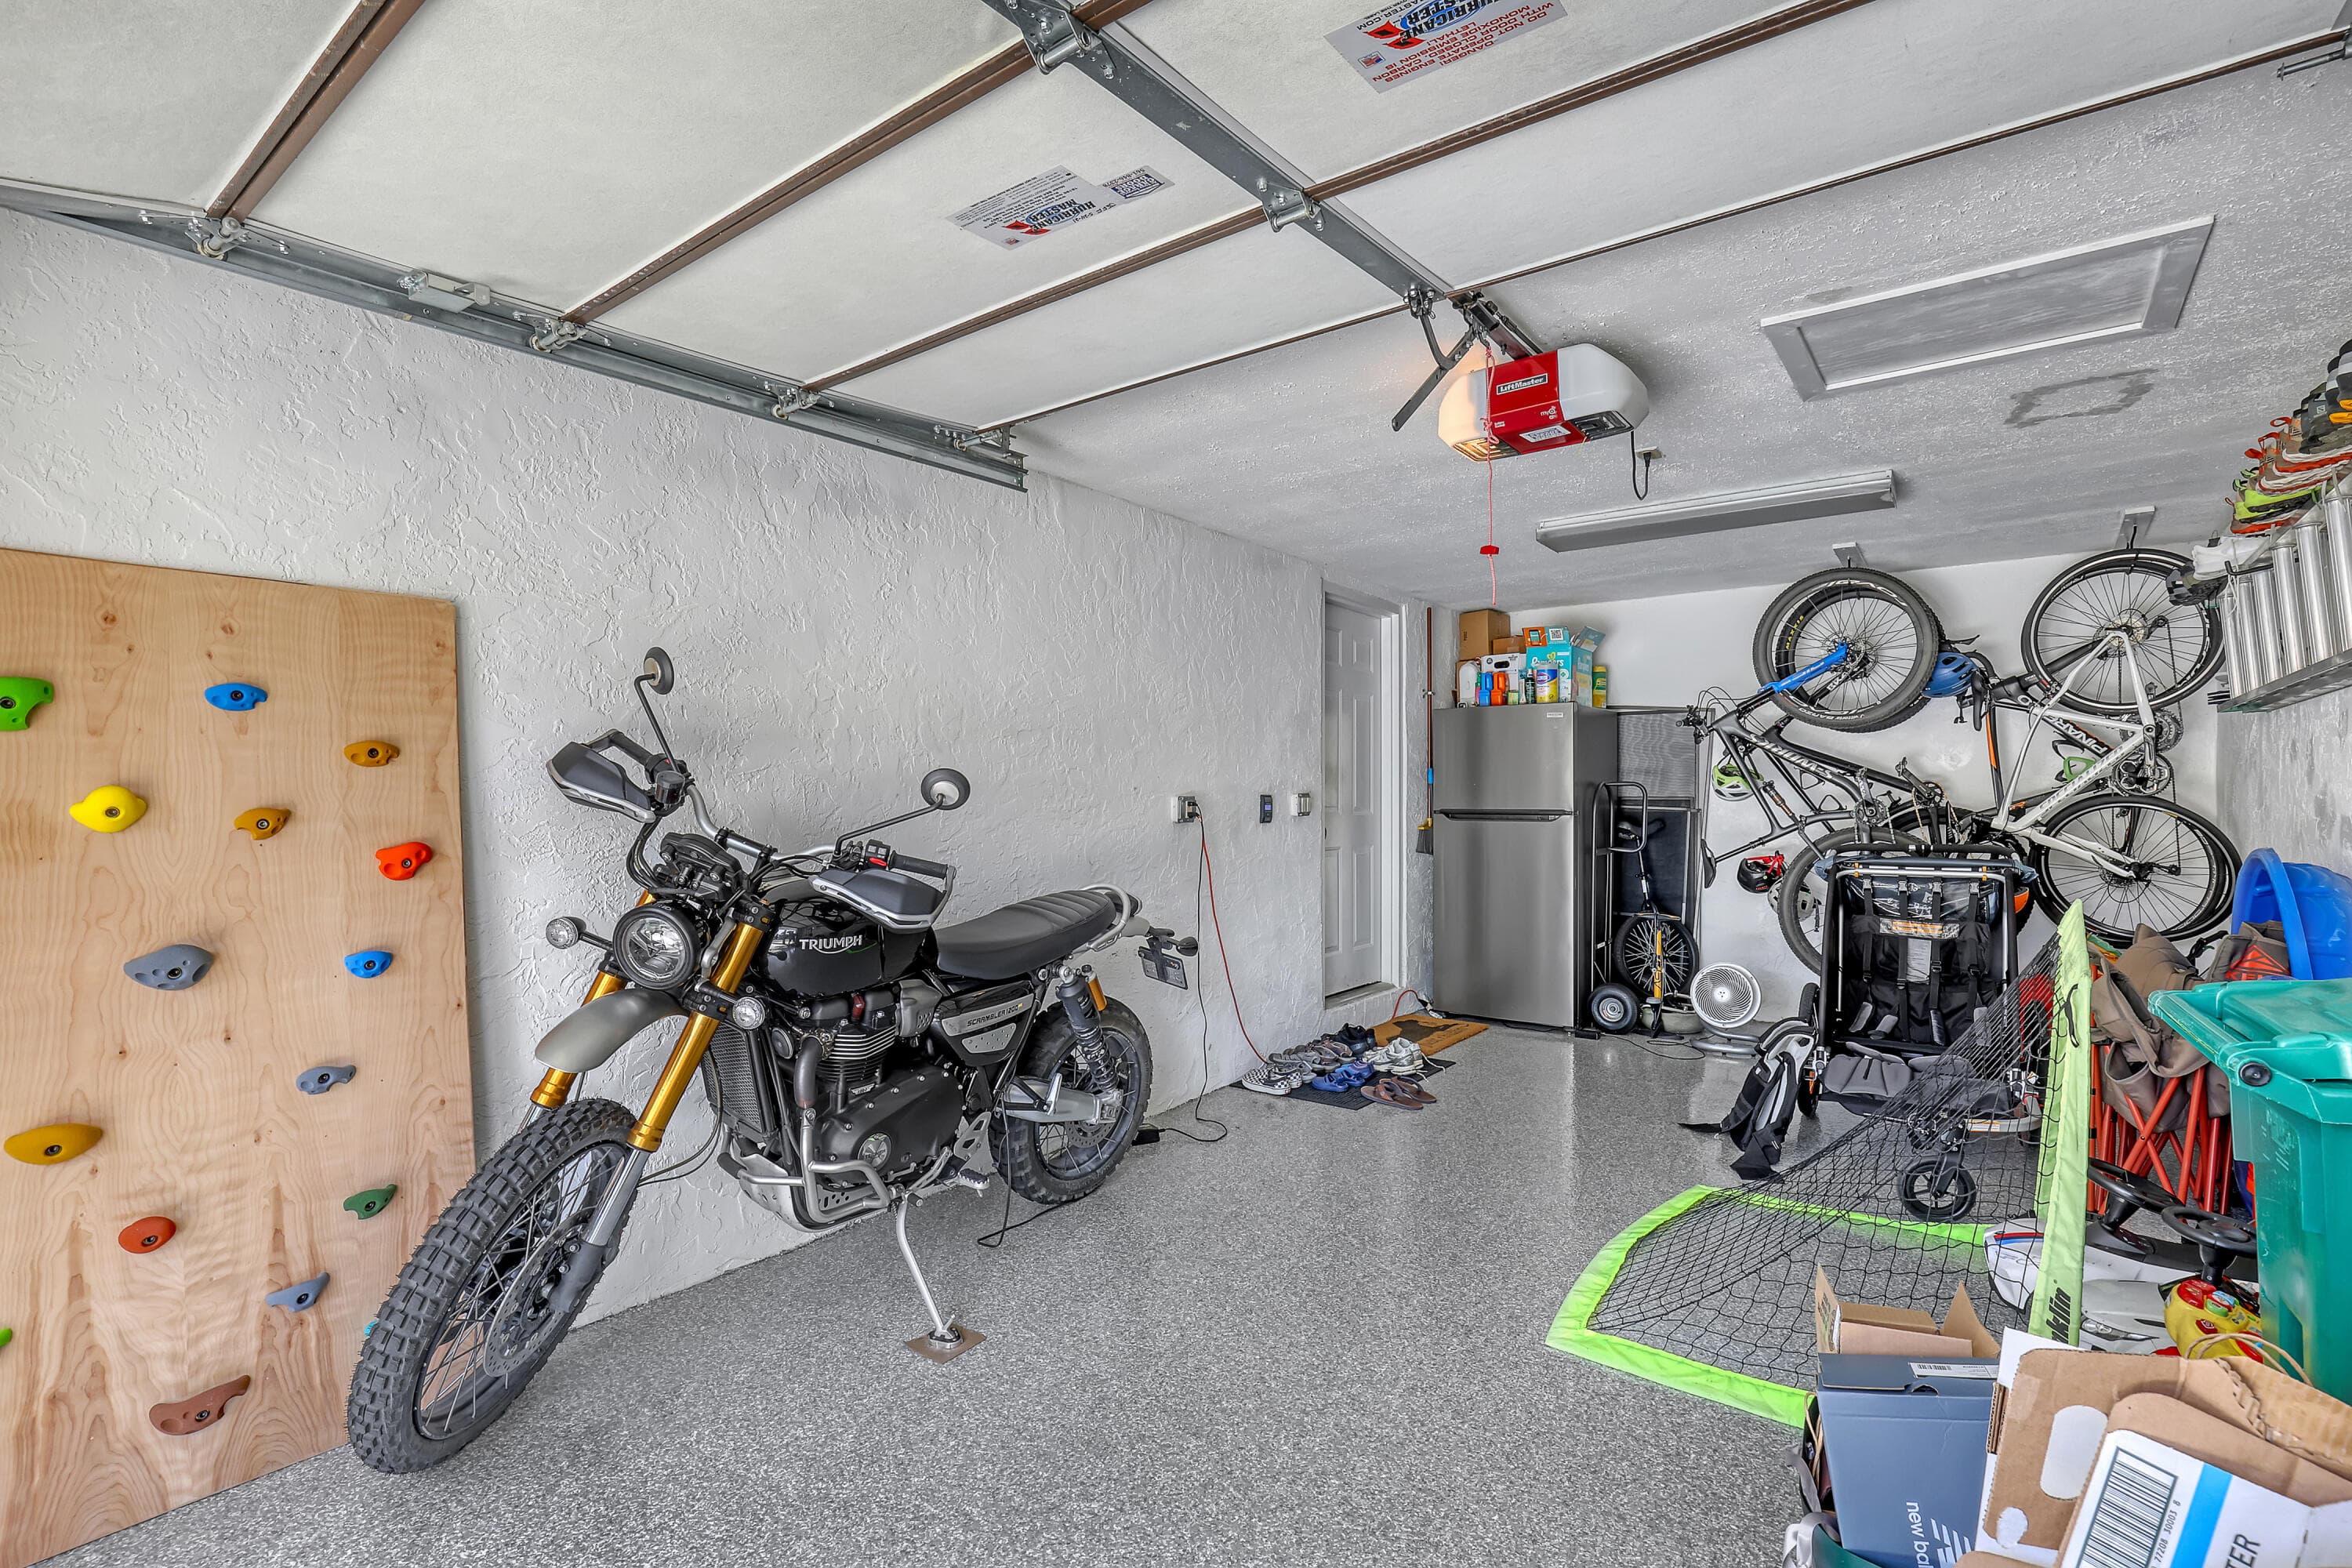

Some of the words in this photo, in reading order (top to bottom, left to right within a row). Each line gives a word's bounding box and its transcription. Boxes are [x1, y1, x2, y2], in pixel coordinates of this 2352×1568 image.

[1459, 5, 1531, 38] MONOXIDE
[1519, 2, 1554, 18] WITH
[1526, 11, 1548, 22] DO
[1425, 21, 1477, 45] LETHAL!
[1479, 17, 1518, 36] DOOR
[1495, 20, 1524, 35] NOT
[1398, 36, 1458, 64] EMISSION
[1424, 34, 1478, 59] CLOSED.
[1436, 34, 1494, 60] OPERATE
[1438, 39, 1495, 65] DANGER!
[1371, 58, 1422, 82] CARBON
[1384, 59, 1436, 82] ENGINES
[1027, 198, 1080, 222] MASTER
[1029, 201, 1097, 231] HURRICANE
[1500, 378, 1544, 392] LiftMaster
[1785, 615, 1805, 650] MAXXIS
[799, 935, 863, 952] TRIUMPH
[1906, 1501, 1925, 1537] new
[2154, 1538, 2169, 1563] 77208
[2164, 1510, 2178, 1534] 30003
